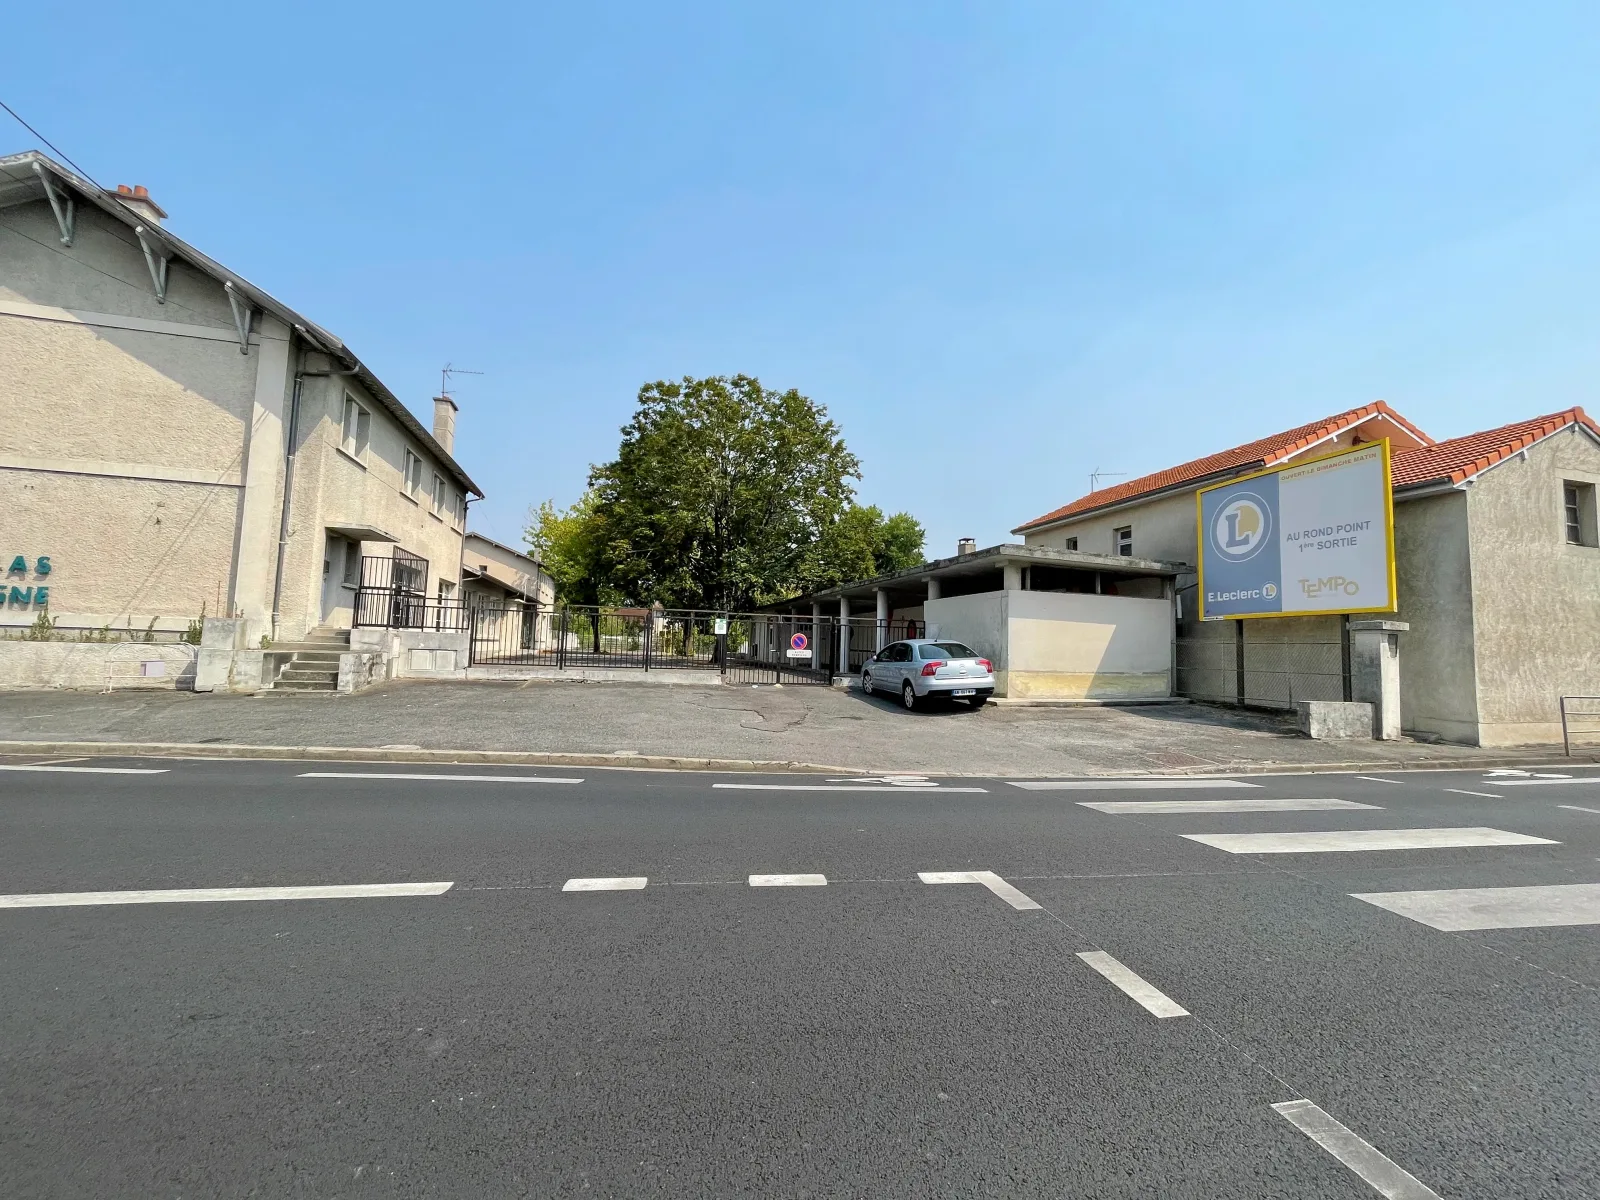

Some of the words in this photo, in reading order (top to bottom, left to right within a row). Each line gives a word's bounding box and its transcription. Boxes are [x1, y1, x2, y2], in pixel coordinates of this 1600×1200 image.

[1281, 472, 1305, 481] OUVERT
[1317, 459, 1352, 471] DIMANCHE
[1353, 452, 1377, 462] MATIN
[1286, 531, 1300, 542] AU
[1304, 526, 1333, 539] ROND
[1336, 520, 1371, 535] POINT
[1299, 541, 1314, 553] 1ère
[1317, 537, 1357, 550] SORTIE
[1298, 576, 1359, 599] TEMPO
